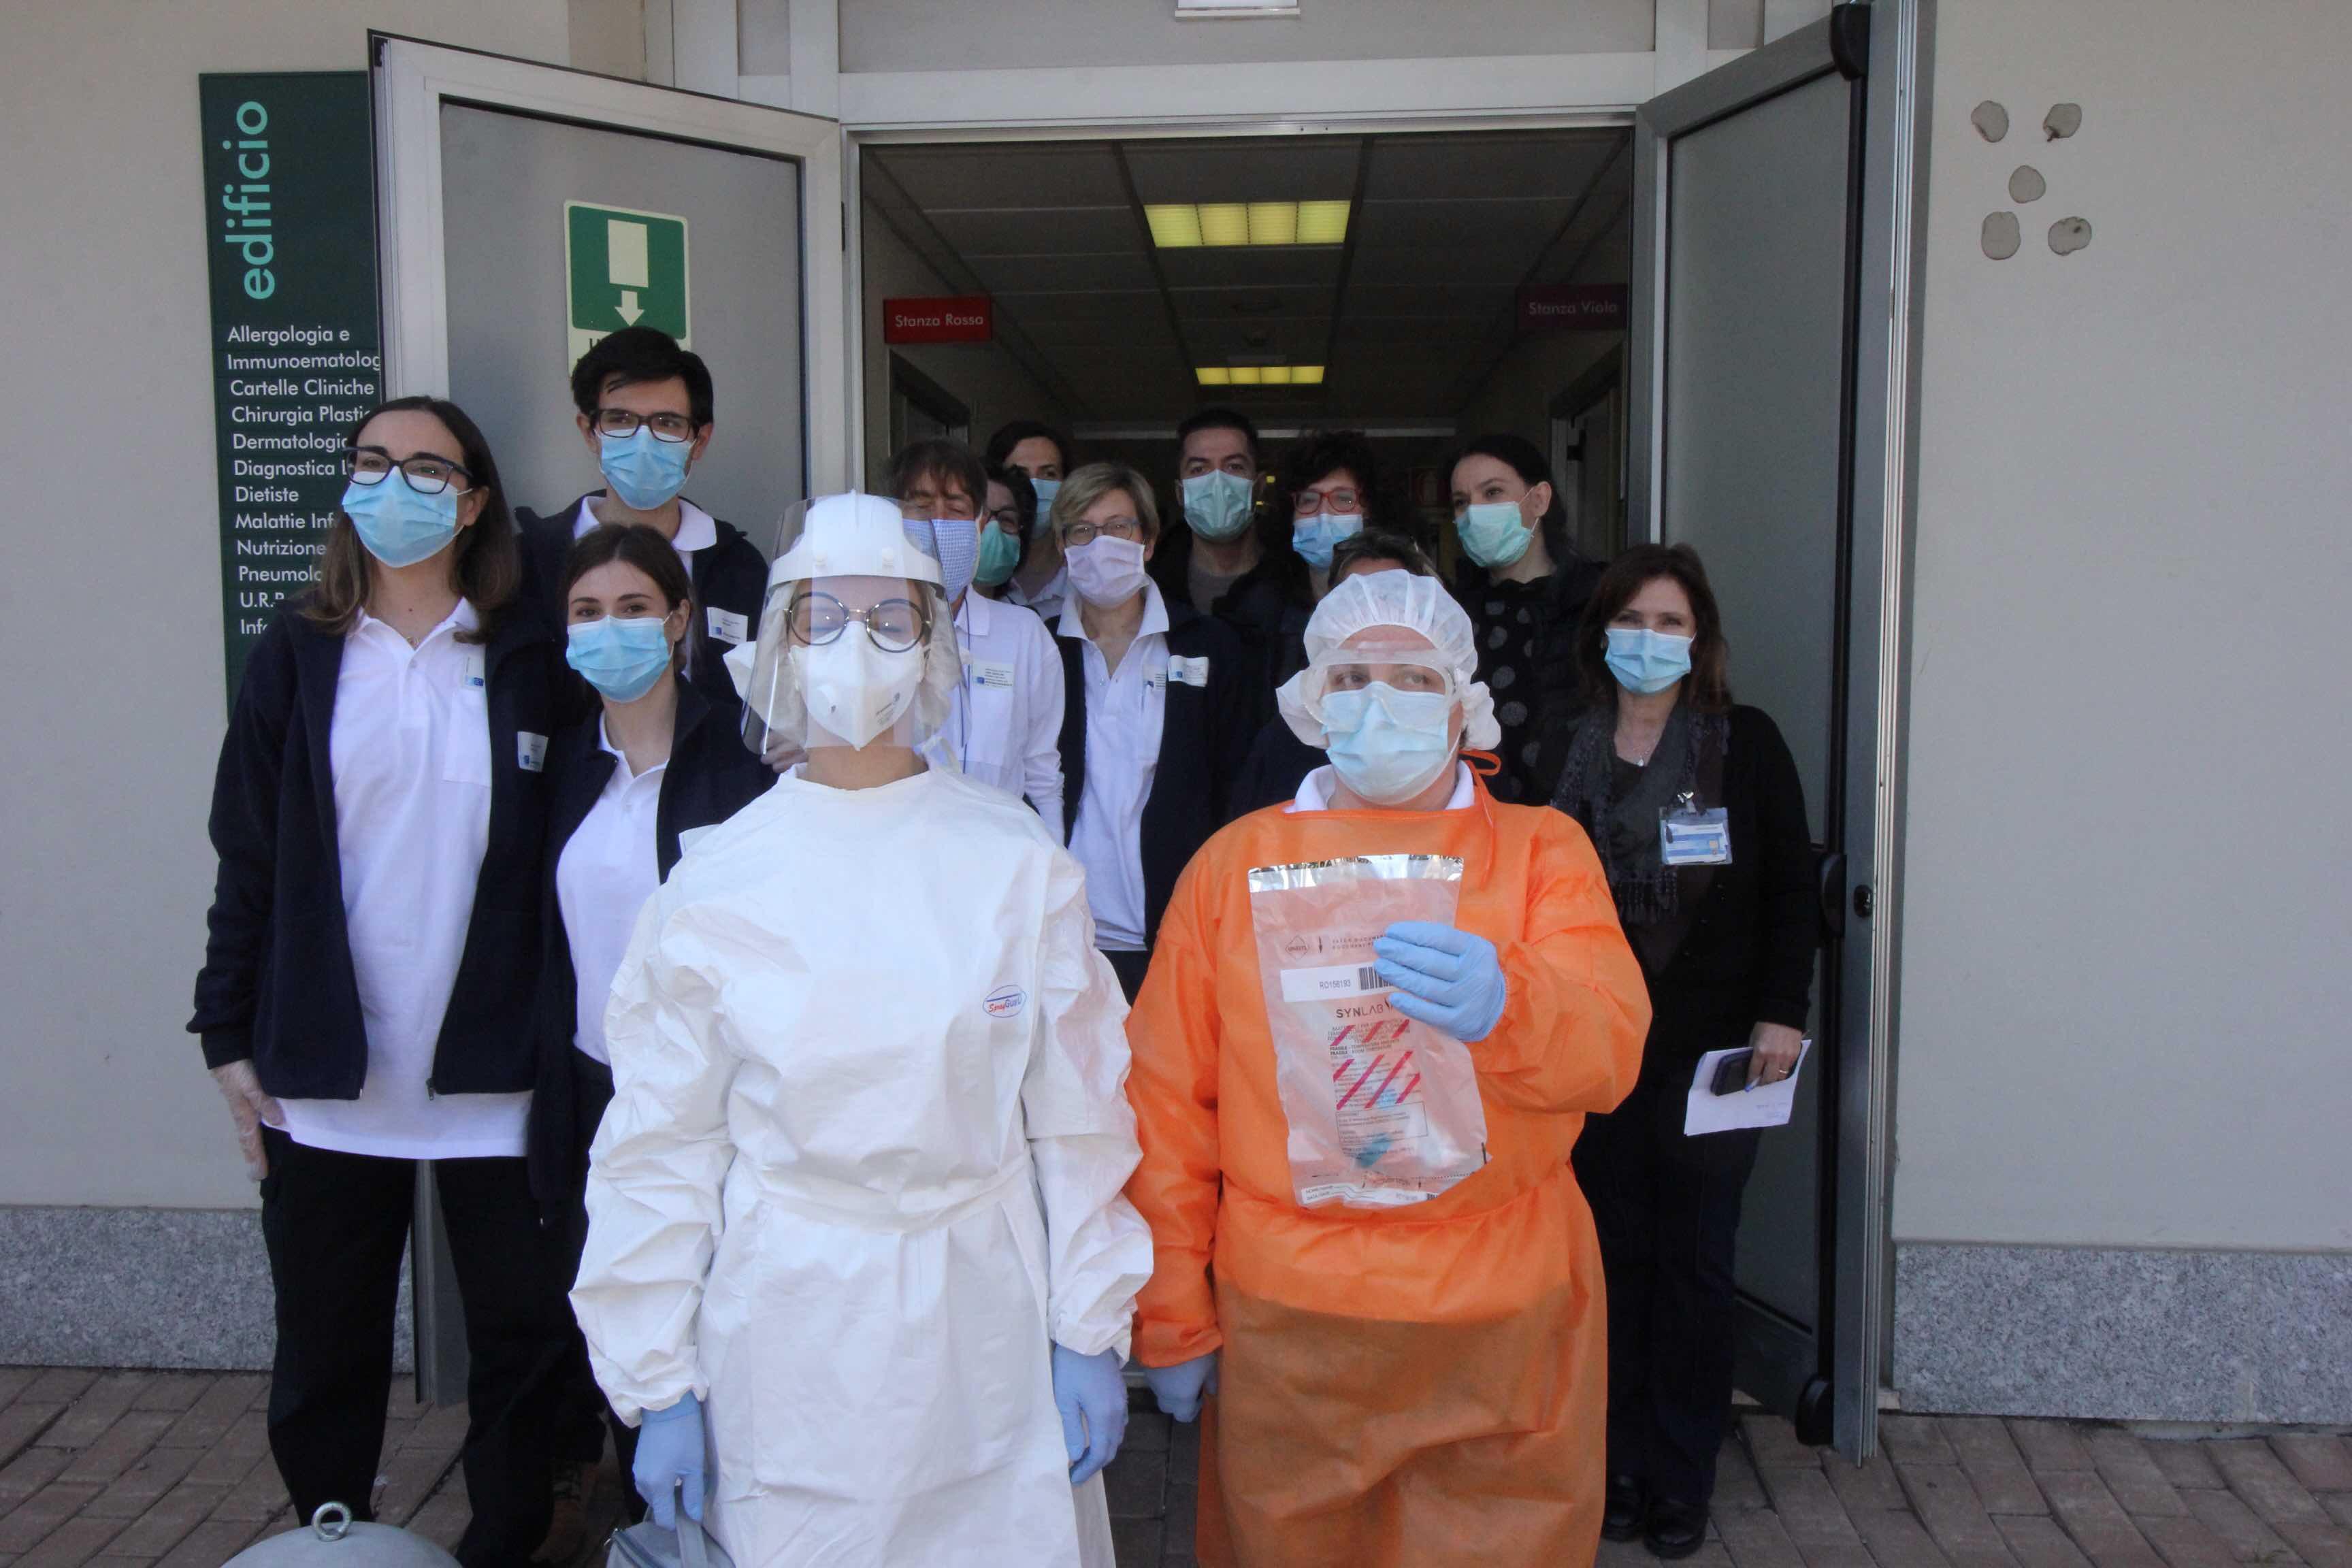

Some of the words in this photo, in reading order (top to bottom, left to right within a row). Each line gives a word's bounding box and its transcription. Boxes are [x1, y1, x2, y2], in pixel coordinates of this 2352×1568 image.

[223, 101, 275, 299] edificio
[1529, 301, 1577, 315] Stanza
[1581, 299, 1618, 314] Viola
[895, 314, 941, 327] Stanza
[945, 313, 984, 325] Rossa
[227, 325, 333, 346] Allergologia
[339, 329, 350, 341] e
[227, 350, 380, 371] Immunoematolog
[230, 378, 299, 396] Cartelle
[304, 378, 374, 395] Cliniche
[231, 406, 313, 427] Chirurgia
[318, 404, 371, 422] Plasti
[234, 459, 336, 480] Diagnostica
[235, 486, 299, 502] Dietiste
[235, 512, 306, 529] Malattie
[311, 512, 334, 529] Inf
[236, 539, 327, 556] Nutrizione
[239, 564, 322, 582] Pneumolo
[1335, 1004, 1384, 1018] SYNLAB
